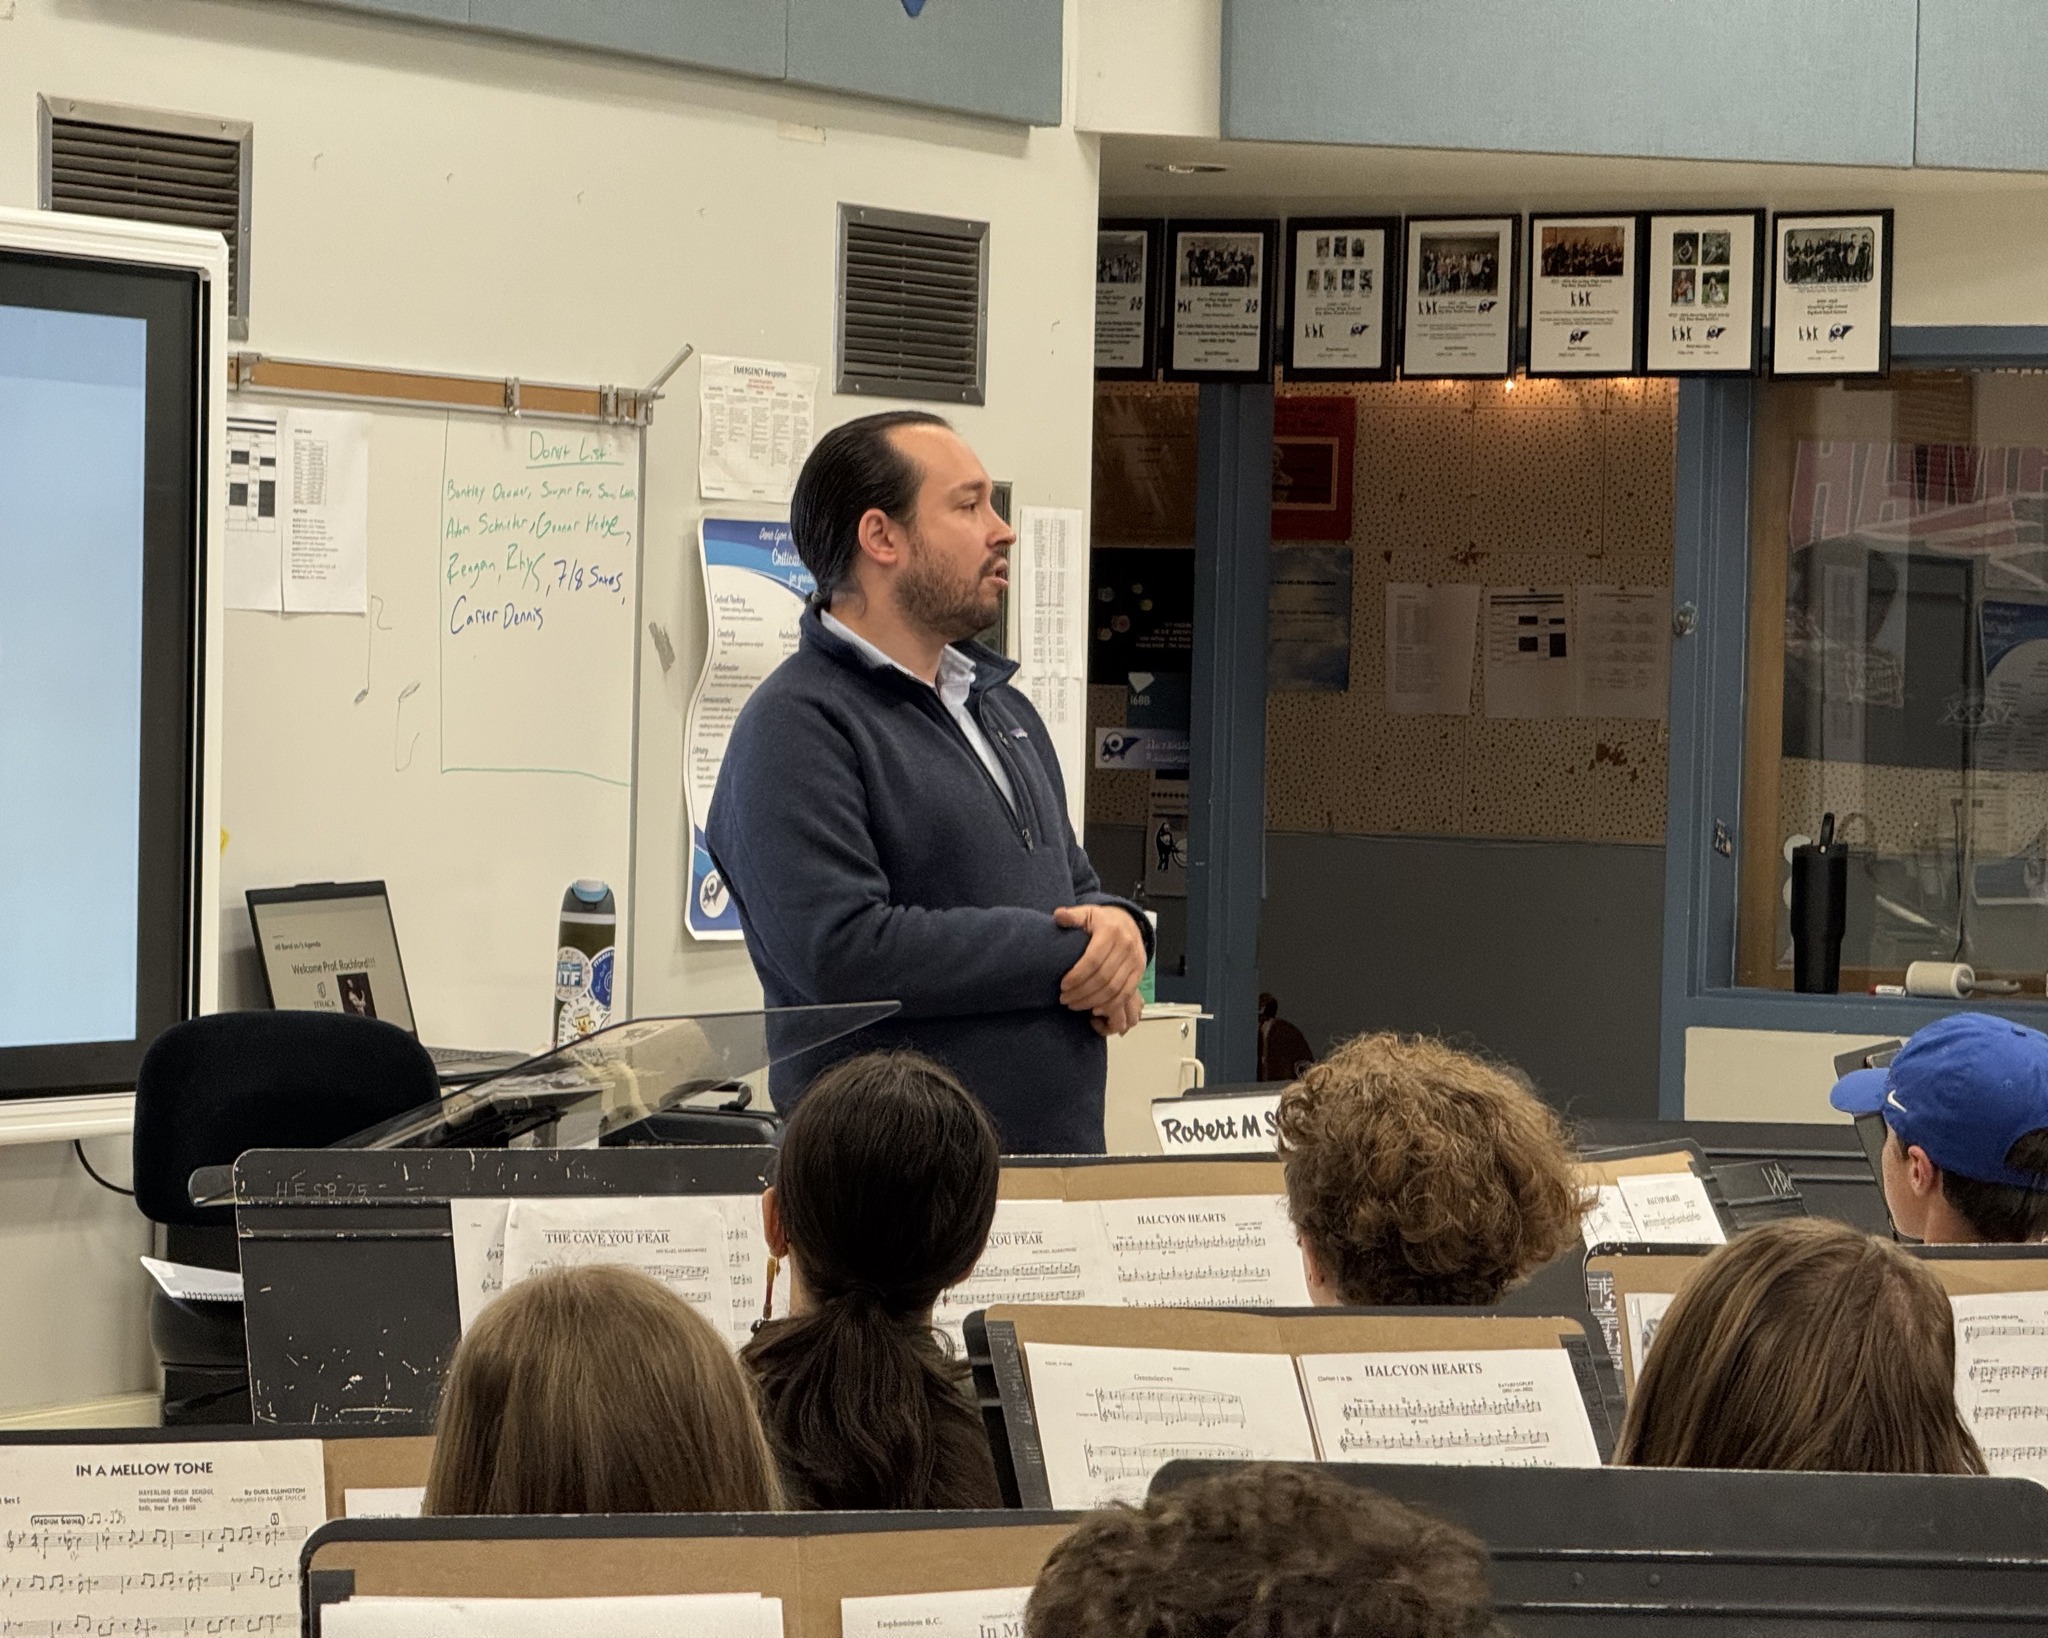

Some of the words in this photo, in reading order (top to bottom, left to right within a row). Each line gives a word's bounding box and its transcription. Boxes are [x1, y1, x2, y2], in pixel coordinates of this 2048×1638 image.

[733, 366, 764, 377] EMERGENCY
[553, 559, 584, 592] 7/8
[503, 602, 544, 631] Dennis
[292, 963, 323, 975] Welcome
[1161, 1116, 1238, 1144] Robert
[1241, 1114, 1262, 1139] M
[1137, 1213, 1186, 1225] HALCYON
[1188, 1212, 1227, 1224] HEARTS
[544, 1233, 571, 1244] THE
[573, 1233, 607, 1244] CAVE
[608, 1233, 634, 1244] YOU
[636, 1232, 670, 1244] FEAR
[988, 1234, 1012, 1246] YOU
[1014, 1233, 1044, 1245] FEAR
[1364, 1364, 1430, 1378] HALCYON
[1432, 1362, 1483, 1375] HEARTS
[76, 1464, 92, 1477] IN
[95, 1464, 107, 1476] A
[110, 1462, 170, 1477] MELLOW
[174, 1461, 214, 1475] TONE
[270, 1487, 306, 1495] ELLINGTON
